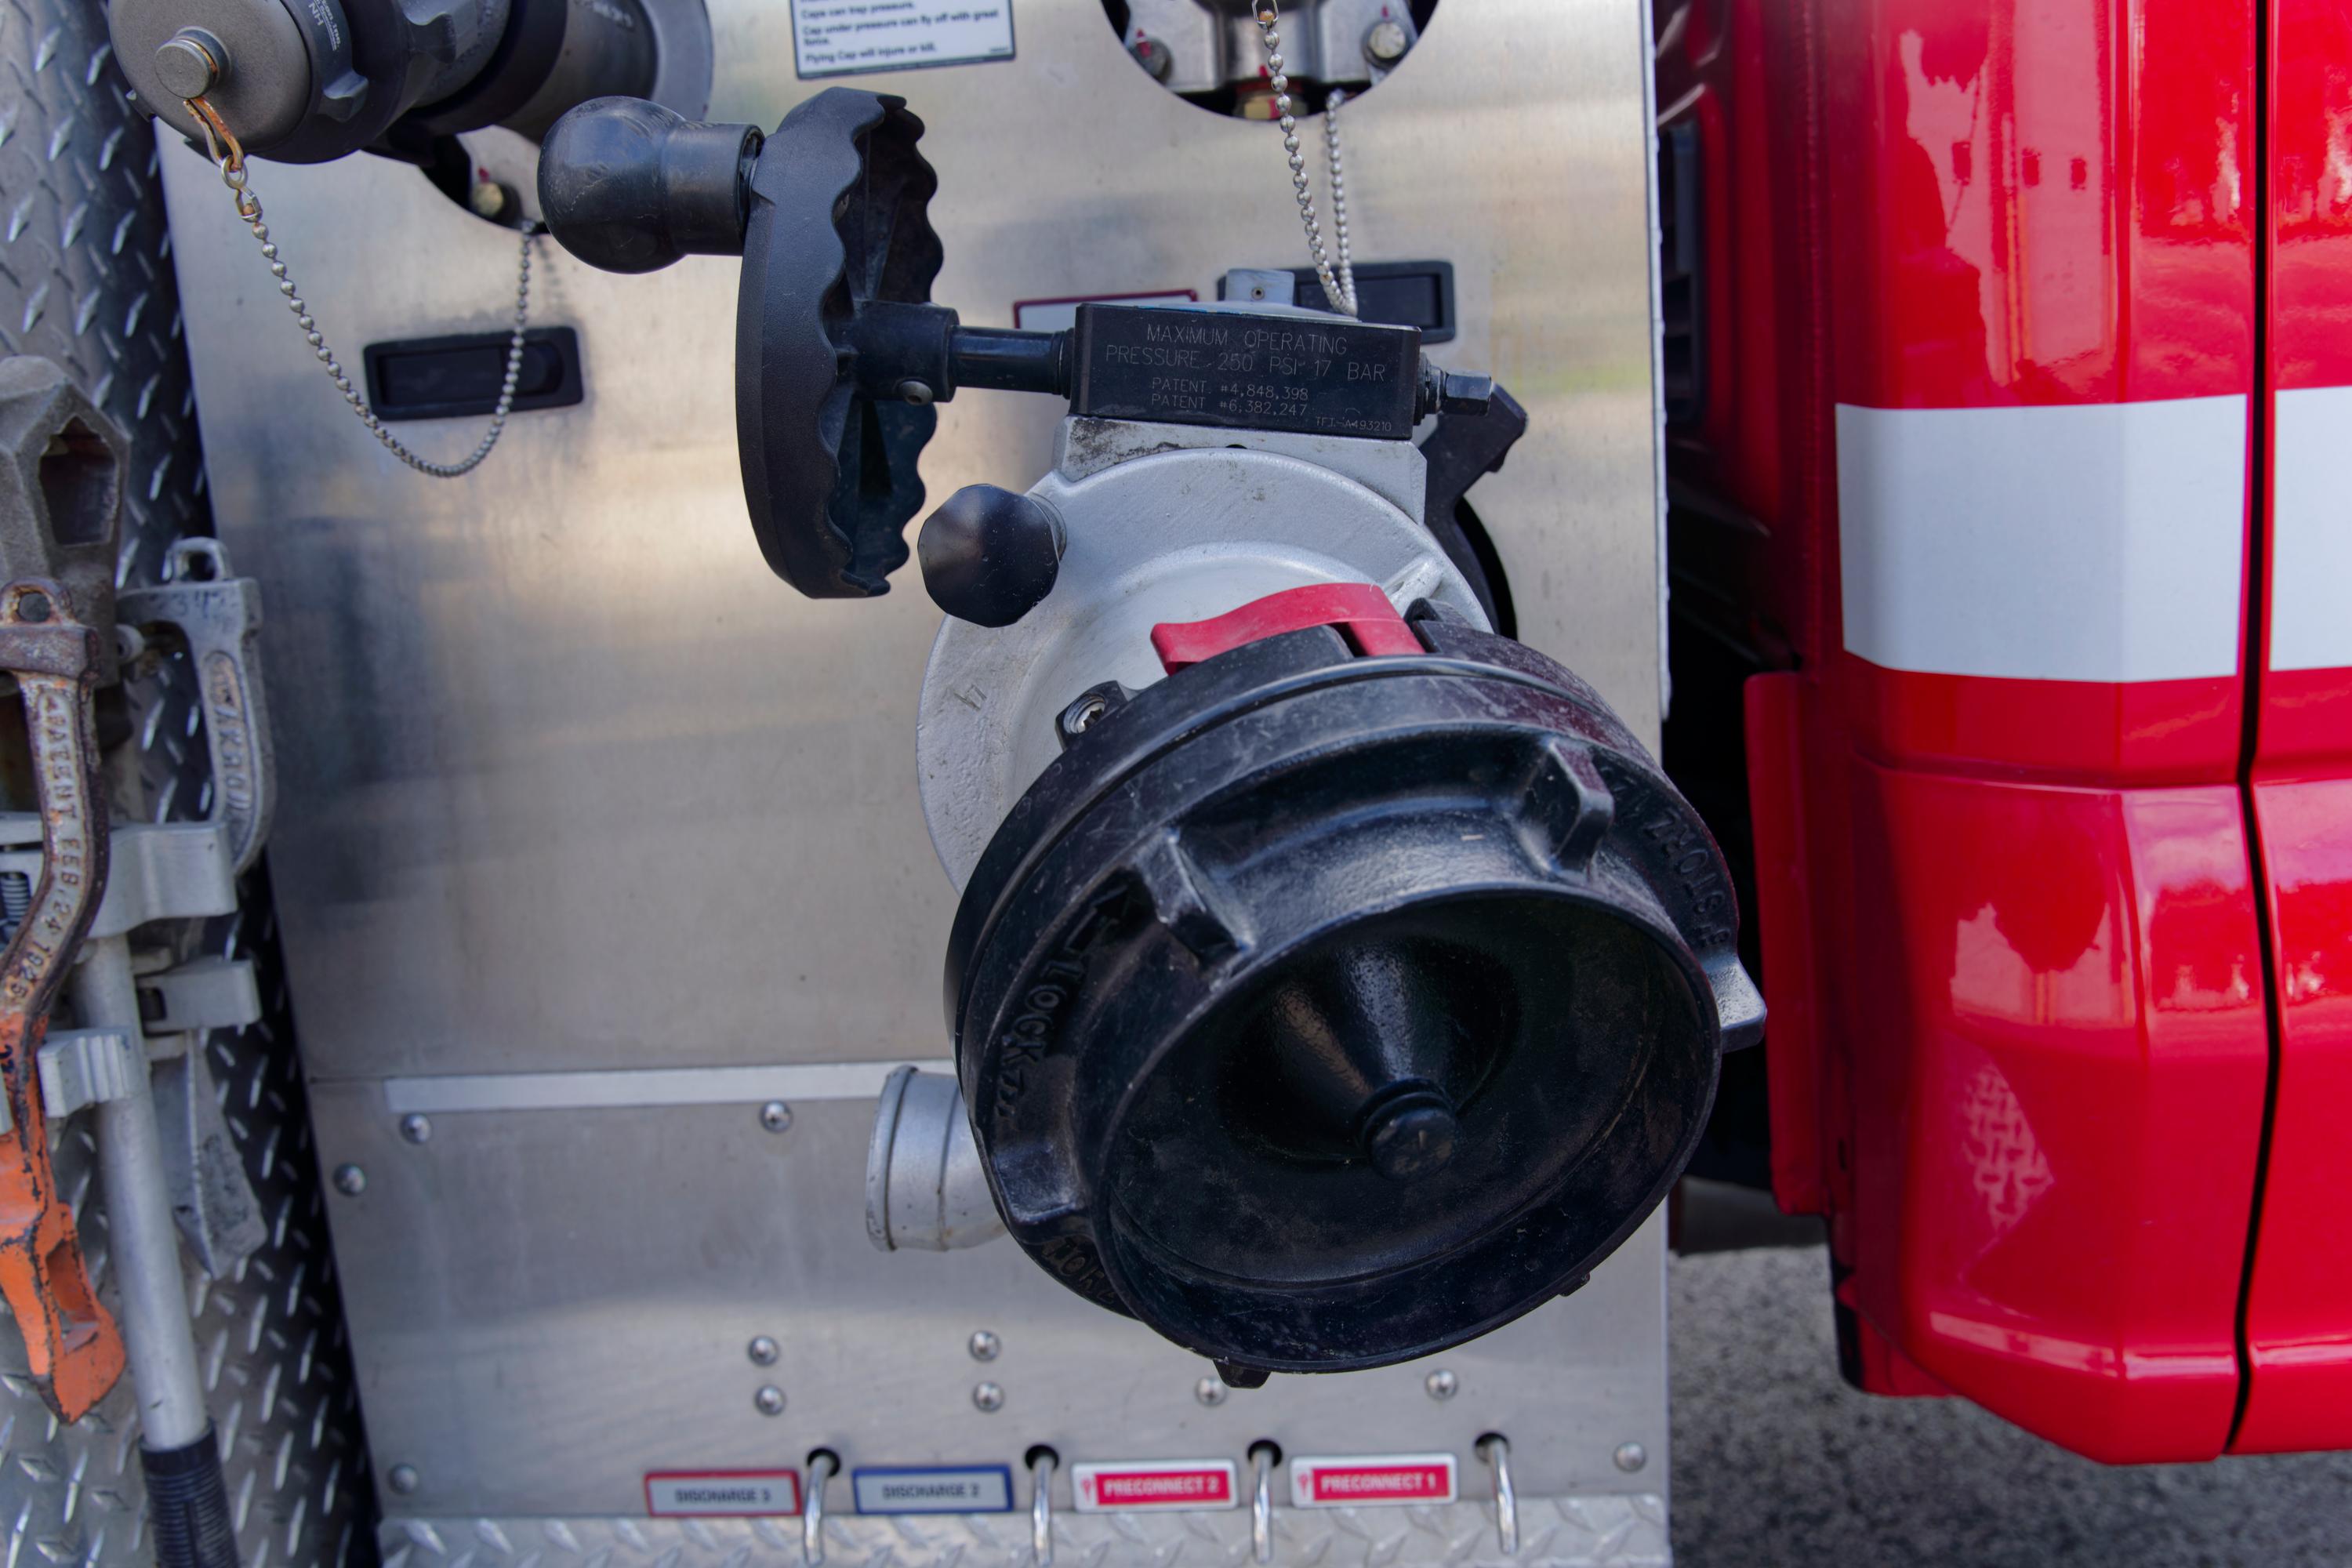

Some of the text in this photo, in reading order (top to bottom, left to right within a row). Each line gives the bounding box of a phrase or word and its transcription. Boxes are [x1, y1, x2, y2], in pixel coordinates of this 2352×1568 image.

[1147, 323, 1348, 355] MAXIMUM OPERATING
[1105, 343, 1201, 368] PRESSURE
[1217, 351, 1255, 372] 250
[1314, 359, 1333, 378] 17
[1347, 362, 1386, 383] BAR
[1220, 382, 1310, 402] #4,848,398
[1150, 392, 1308, 417] PATENT #6,382,247
[1002, 959, 1087, 1065] LOCK
[882, 1484, 967, 1499] DISCHARGE
[1104, 1477, 1204, 1496] PRECONNECT
[1321, 1472, 1436, 1491] PRECONNECT 1
[675, 1489, 756, 1504] DISCHARGE
